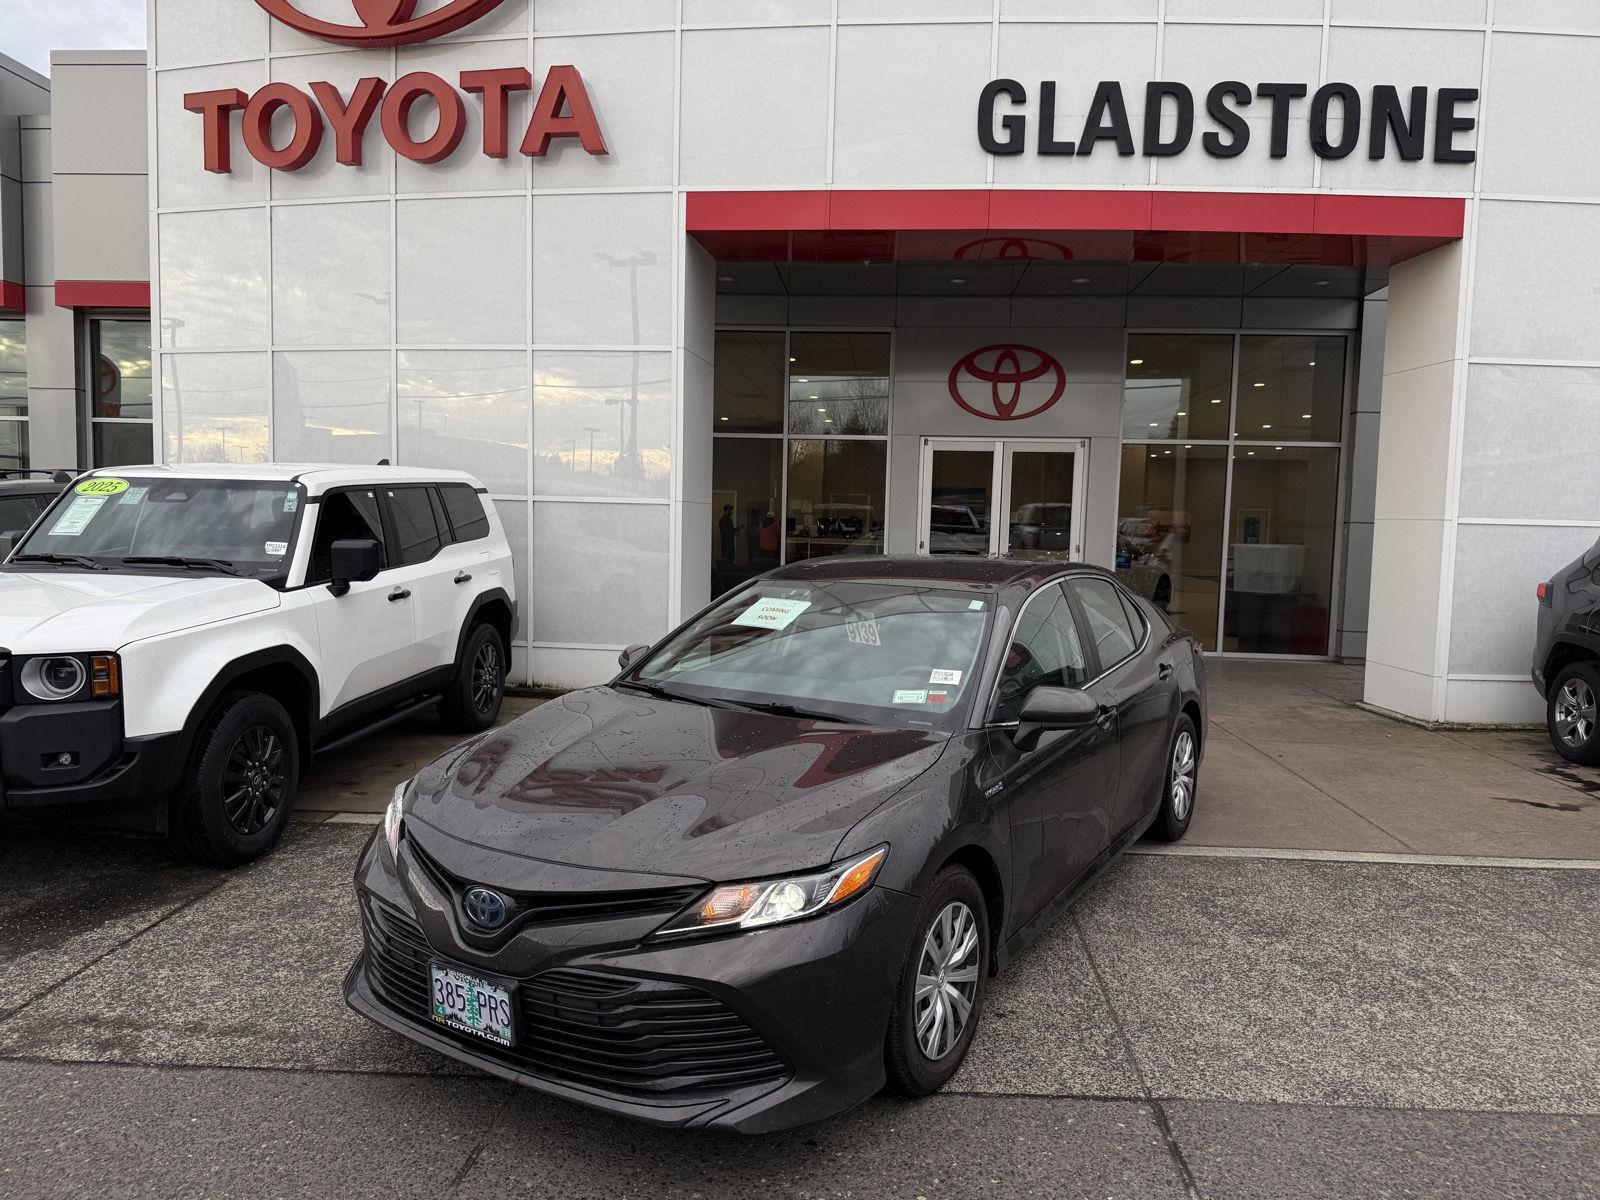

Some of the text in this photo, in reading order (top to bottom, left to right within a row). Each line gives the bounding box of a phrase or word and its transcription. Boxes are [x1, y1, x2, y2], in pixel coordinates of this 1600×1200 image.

[184, 65, 609, 174] TOYOTA
[977, 78, 1479, 163] GLADSTONE
[81, 481, 123, 493] 2025
[761, 606, 792, 614] COMING
[849, 620, 878, 644] 9139
[434, 978, 511, 1027] 385 PRS
